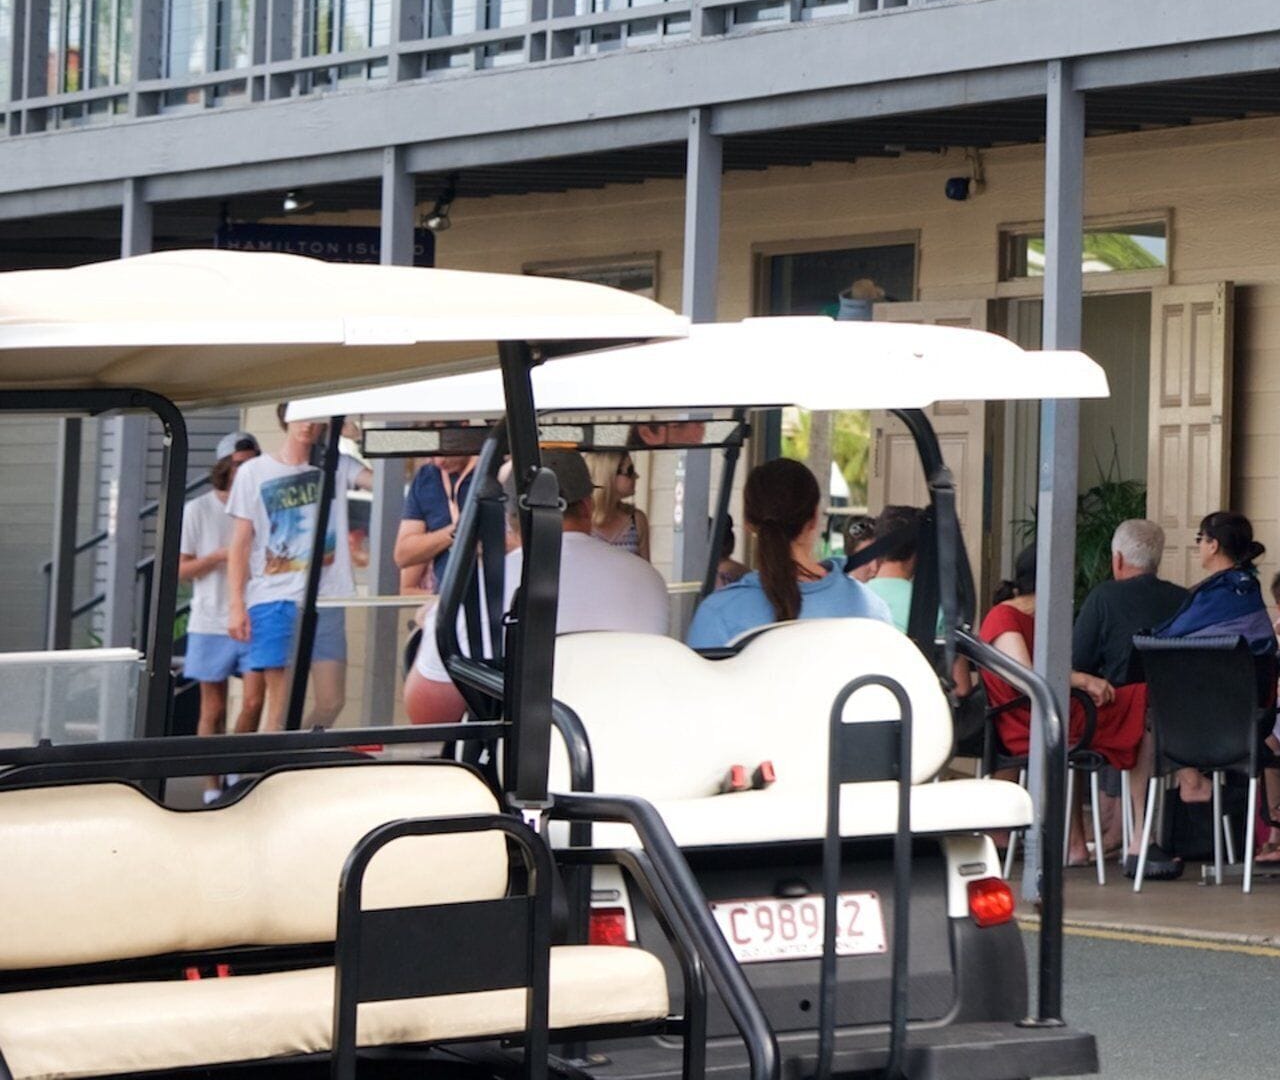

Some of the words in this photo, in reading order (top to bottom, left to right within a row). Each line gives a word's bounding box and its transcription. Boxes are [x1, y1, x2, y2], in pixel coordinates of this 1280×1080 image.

[228, 240, 339, 255] HAMILTON
[348, 242, 425, 256] ISLD
[730, 900, 864, 945] C9892
